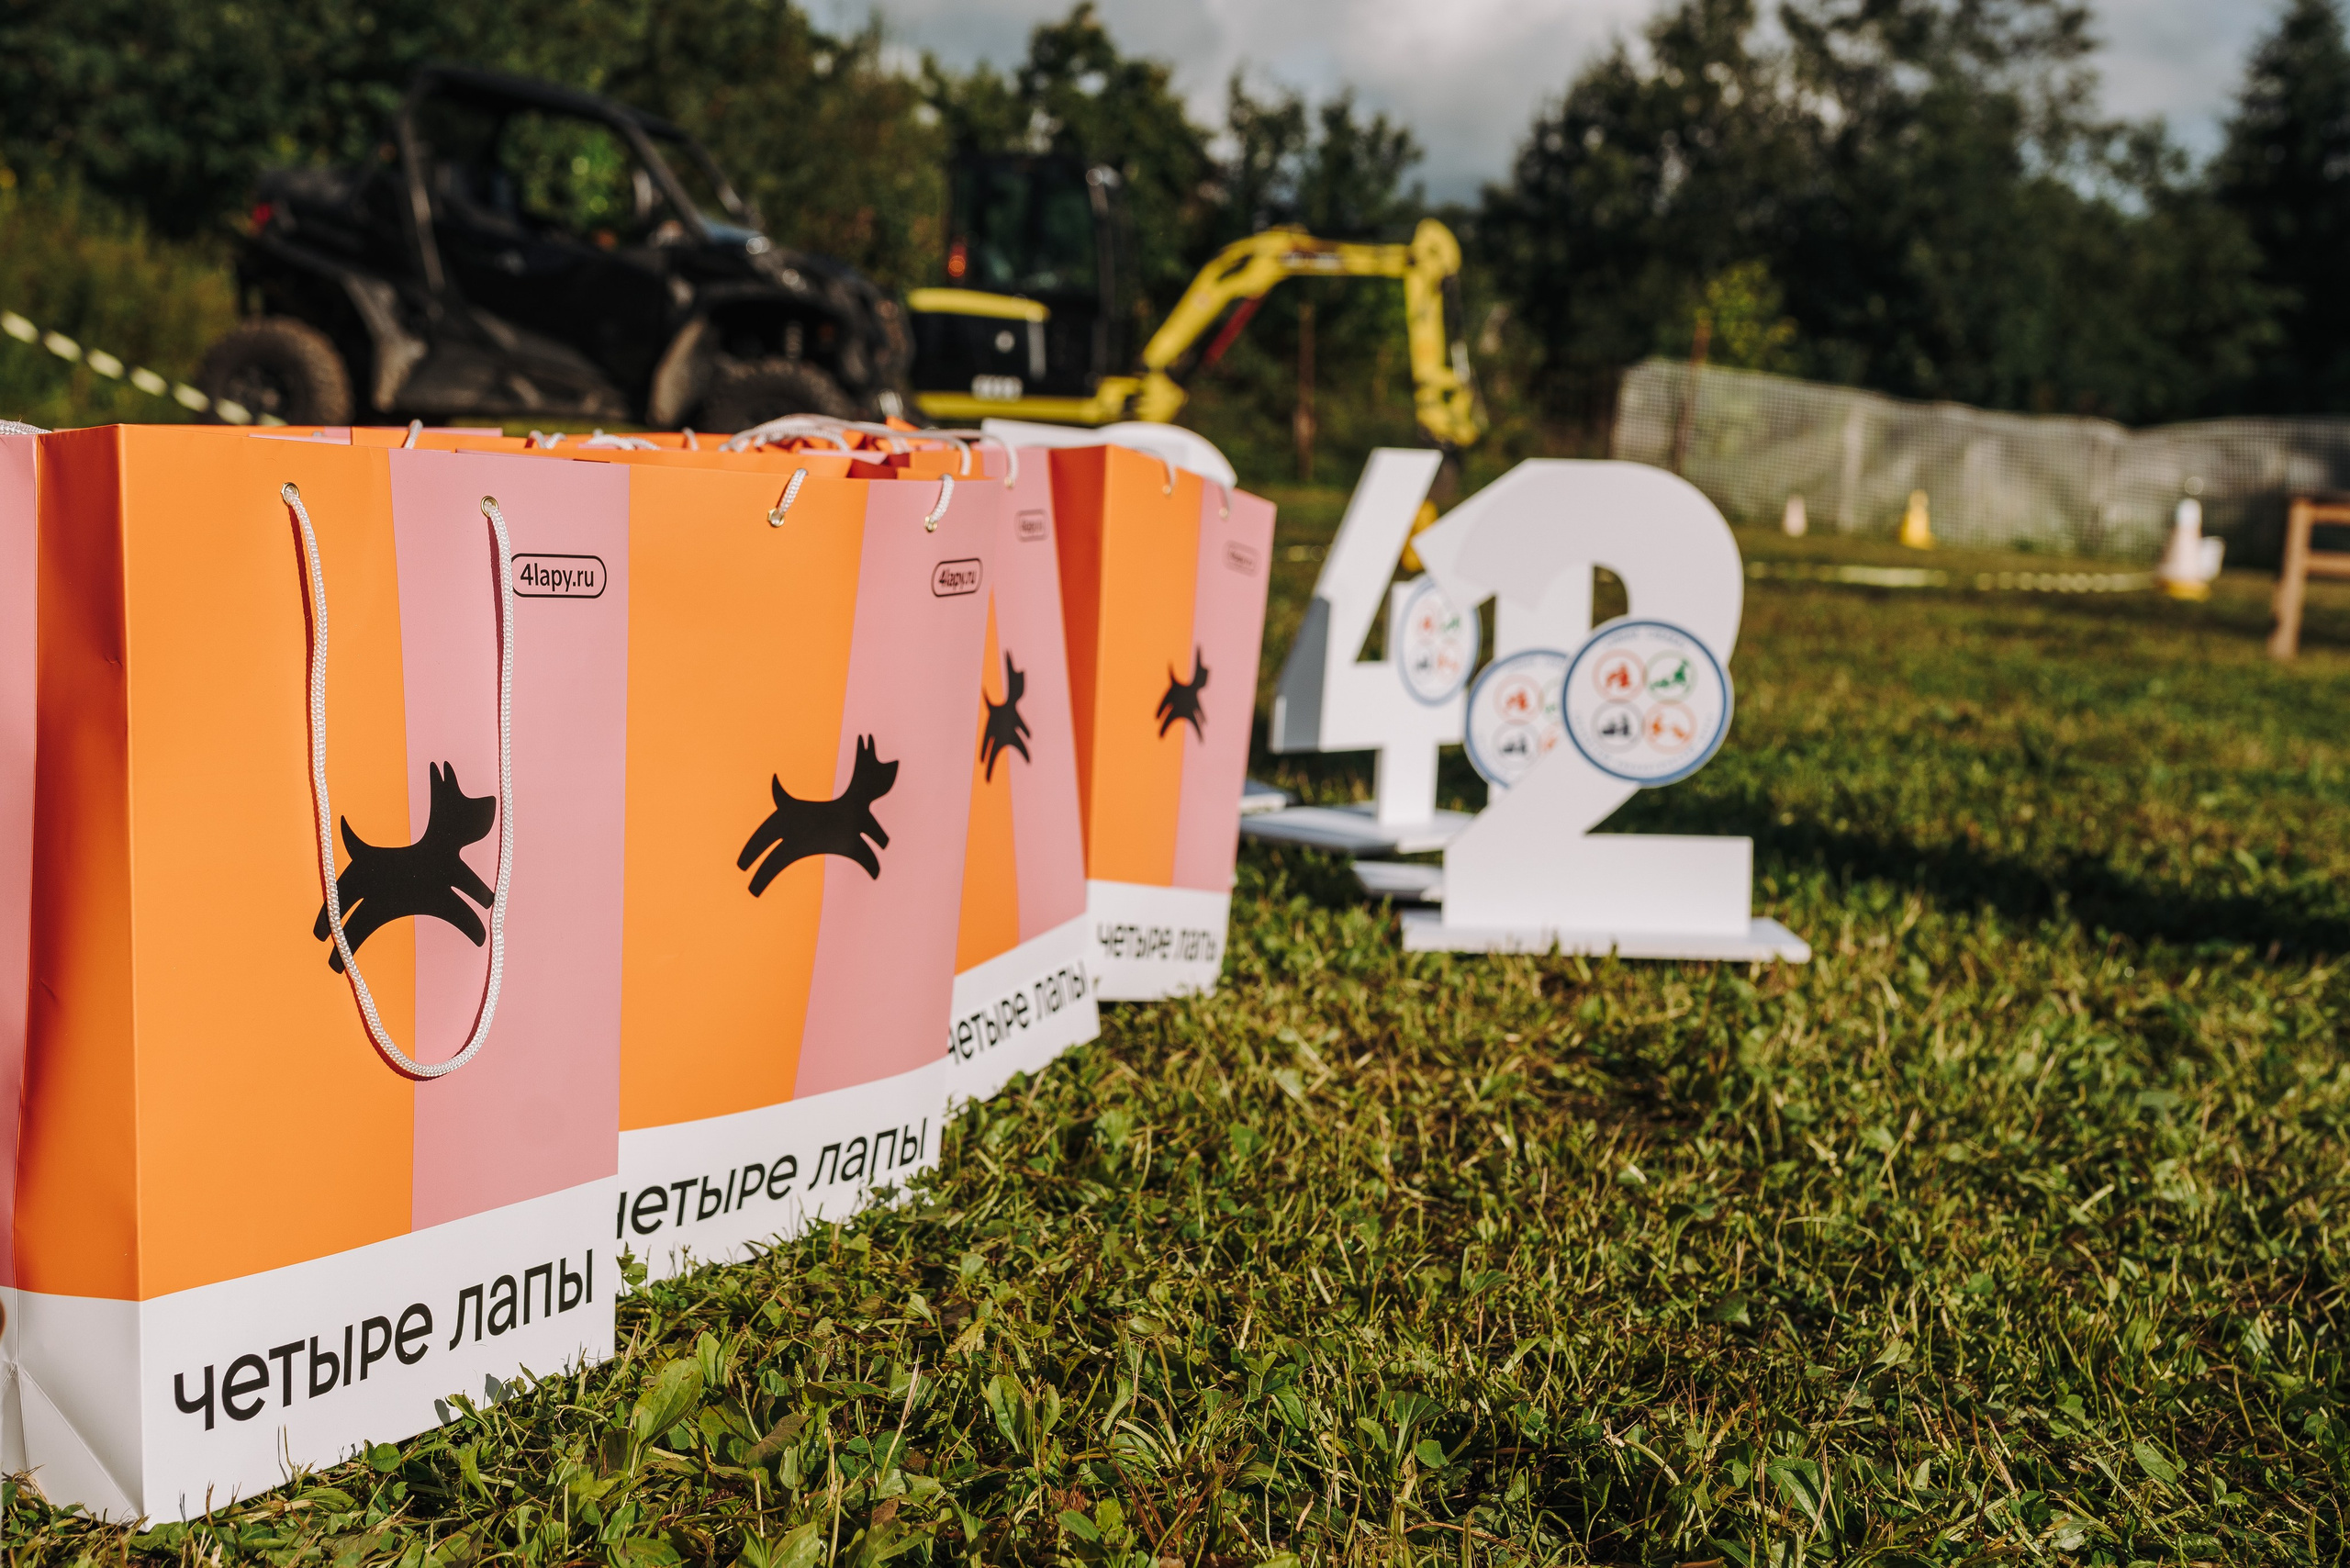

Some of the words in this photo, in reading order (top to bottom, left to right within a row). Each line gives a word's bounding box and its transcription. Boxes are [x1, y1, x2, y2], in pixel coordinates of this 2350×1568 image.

[520, 563, 594, 592] 4lapy.ru
[1034, 958, 1089, 1021] лапы
[808, 1117, 927, 1191] лапы
[173, 1302, 433, 1431] четыре
[449, 1249, 593, 1350] лапы
